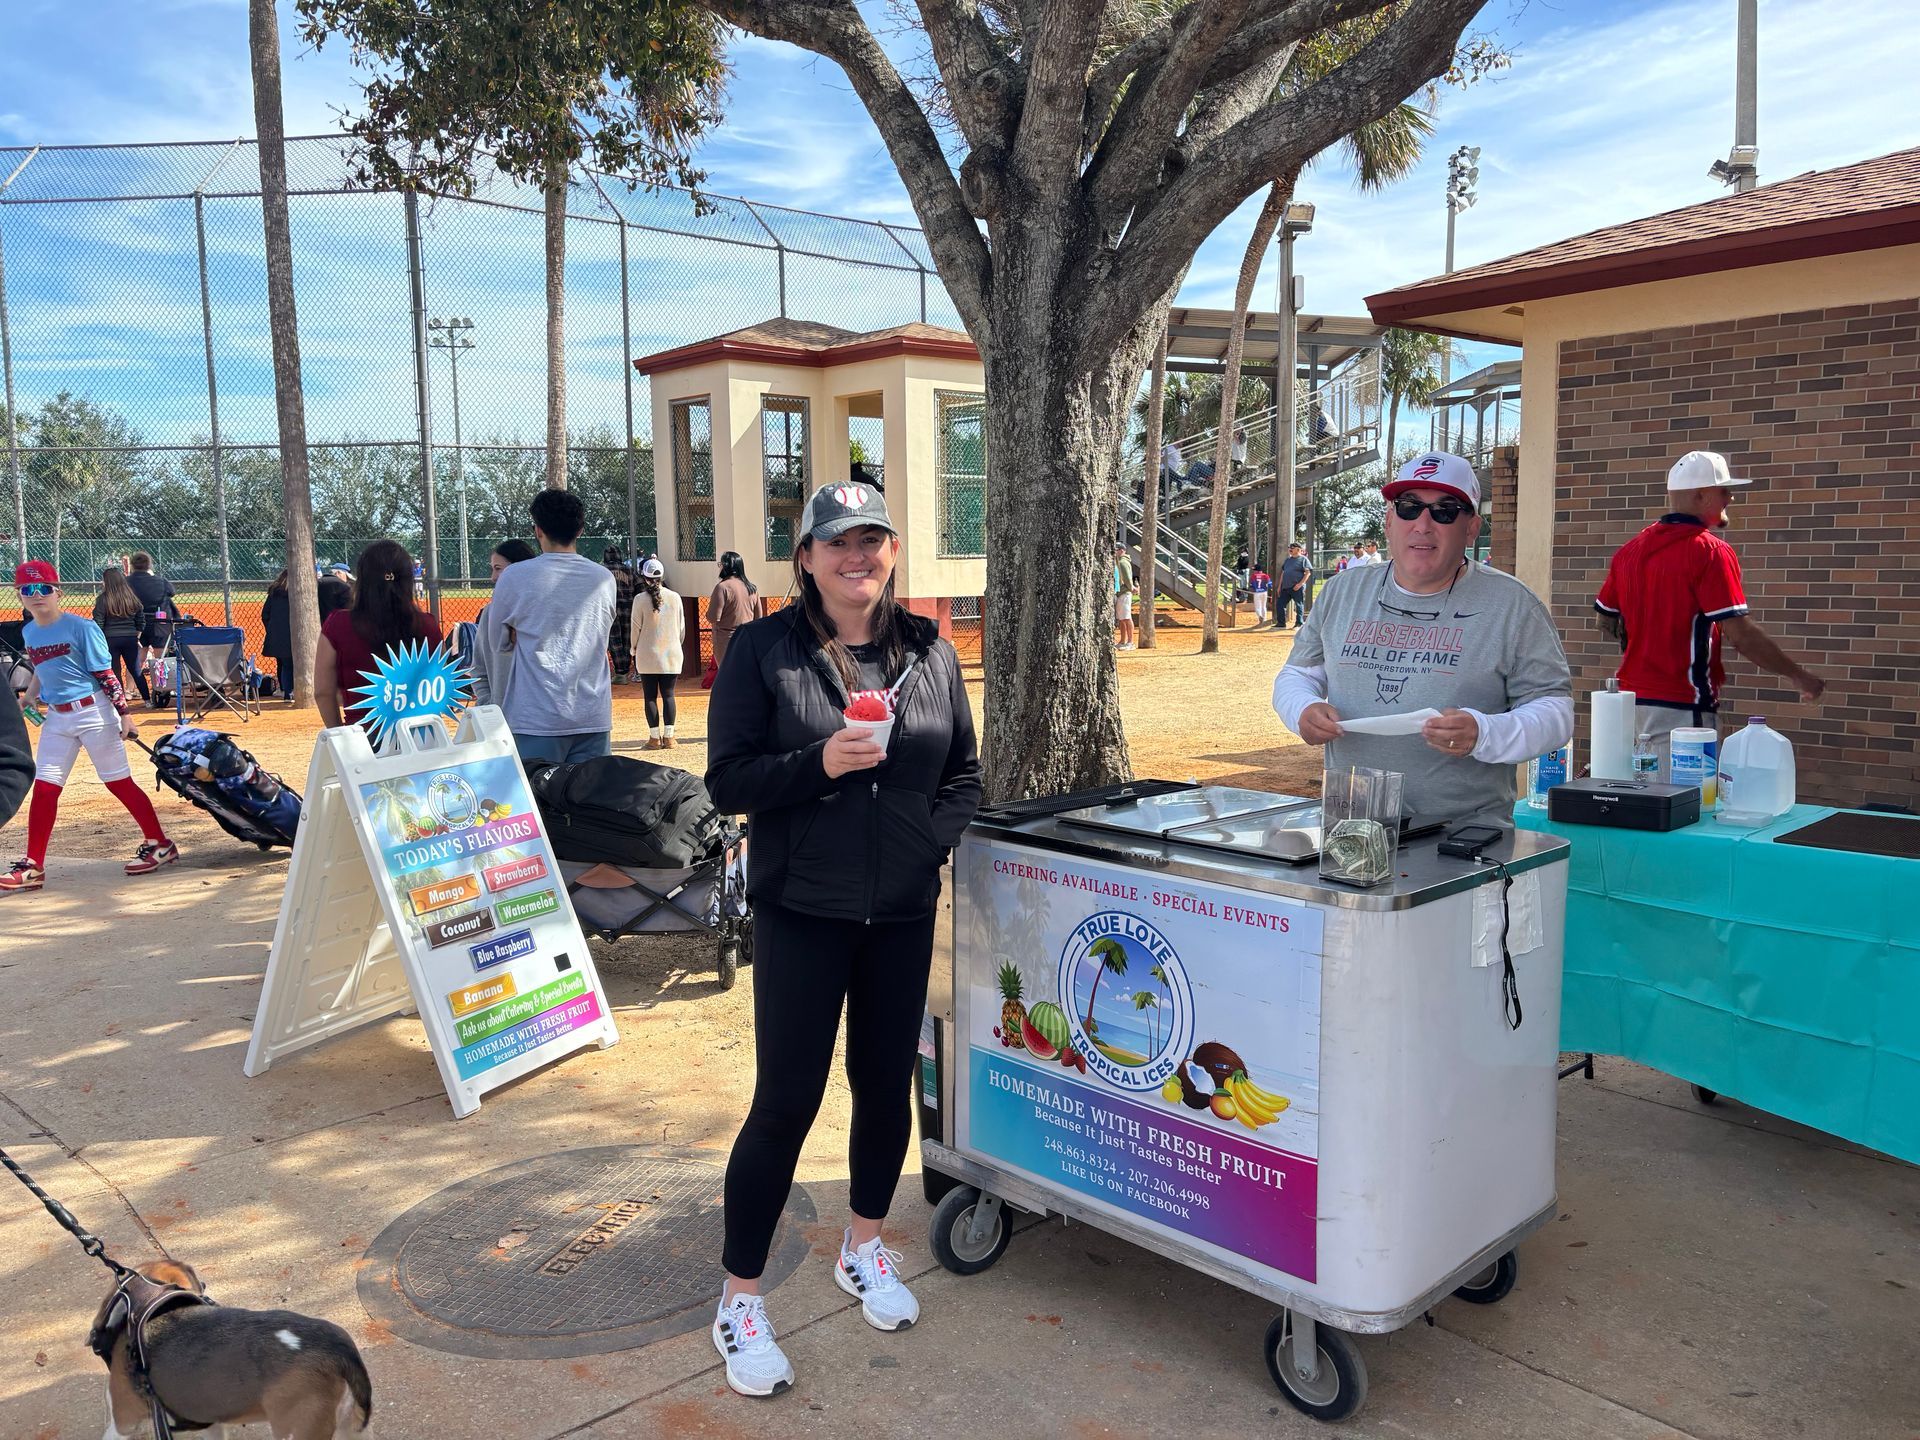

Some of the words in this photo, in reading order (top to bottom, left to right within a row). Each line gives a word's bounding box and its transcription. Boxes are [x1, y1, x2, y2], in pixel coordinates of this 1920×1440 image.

[1340, 645, 1378, 660] HALL
[1386, 650, 1408, 663] OF
[1412, 651, 1460, 667] FAME
[1346, 620, 1464, 653] BASEBALL
[383, 675, 446, 712] $5.00
[1380, 684, 1399, 693] 1939
[430, 775, 444, 789] TRUE
[444, 774, 462, 783] LOVE
[393, 838, 464, 870] TODAY'S
[465, 820, 532, 851] FLAVORS
[428, 884, 464, 904] Mango
[493, 864, 540, 886] Strawberry
[502, 895, 554, 919] Watermelon
[993, 859, 1058, 884] CATERING
[1061, 873, 1139, 901] AVAILABLE
[1152, 892, 1218, 918] SPECIAL
[1223, 905, 1290, 933] EVENTS
[440, 915, 481, 938] Coconut
[1077, 914, 1121, 945] TRUE
[1125, 916, 1172, 965] LOVE
[477, 946, 495, 964] Blue
[495, 936, 531, 958] Raspberry
[462, 1021, 477, 1039] Ask
[477, 1020, 487, 1032] us
[487, 1008, 506, 1028] about
[505, 998, 535, 1020] Catering
[533, 993, 540, 1008] &
[540, 983, 563, 1007] Special
[562, 975, 583, 995] Events
[463, 982, 504, 1006] Banana
[464, 1033, 516, 1065] HOMEMADE
[516, 1022, 540, 1044] WITH
[541, 1011, 566, 1033] FRESH
[568, 1000, 591, 1021] FRUIT
[493, 1048, 518, 1064] Because
[523, 1038, 538, 1054] Just
[536, 1032, 556, 1047] Tastes
[554, 1023, 573, 1038] Better
[1072, 1029, 1141, 1086] TROPICAL
[1144, 1056, 1175, 1085] ICES
[988, 1069, 1085, 1120] HOMEMADE
[1090, 1105, 1142, 1140] WITH
[1147, 1126, 1213, 1165] FRESH
[1219, 1153, 1287, 1190] FRUIT
[1034, 1105, 1082, 1134] Because
[1085, 1124, 1096, 1140] It
[1098, 1129, 1126, 1151] Just
[1128, 1140, 1173, 1167] Tastes
[1177, 1157, 1222, 1186] Better
[1044, 1135, 1117, 1175] 248.863.8324
[1128, 1167, 1211, 1210] 207.206.4998
[1061, 1160, 1087, 1181] LIKE
[1089, 1170, 1105, 1186] US
[1107, 1178, 1123, 1194] ON
[1127, 1187, 1191, 1220] FACEBOOK
[544, 1203, 642, 1275] ELECTRIC
